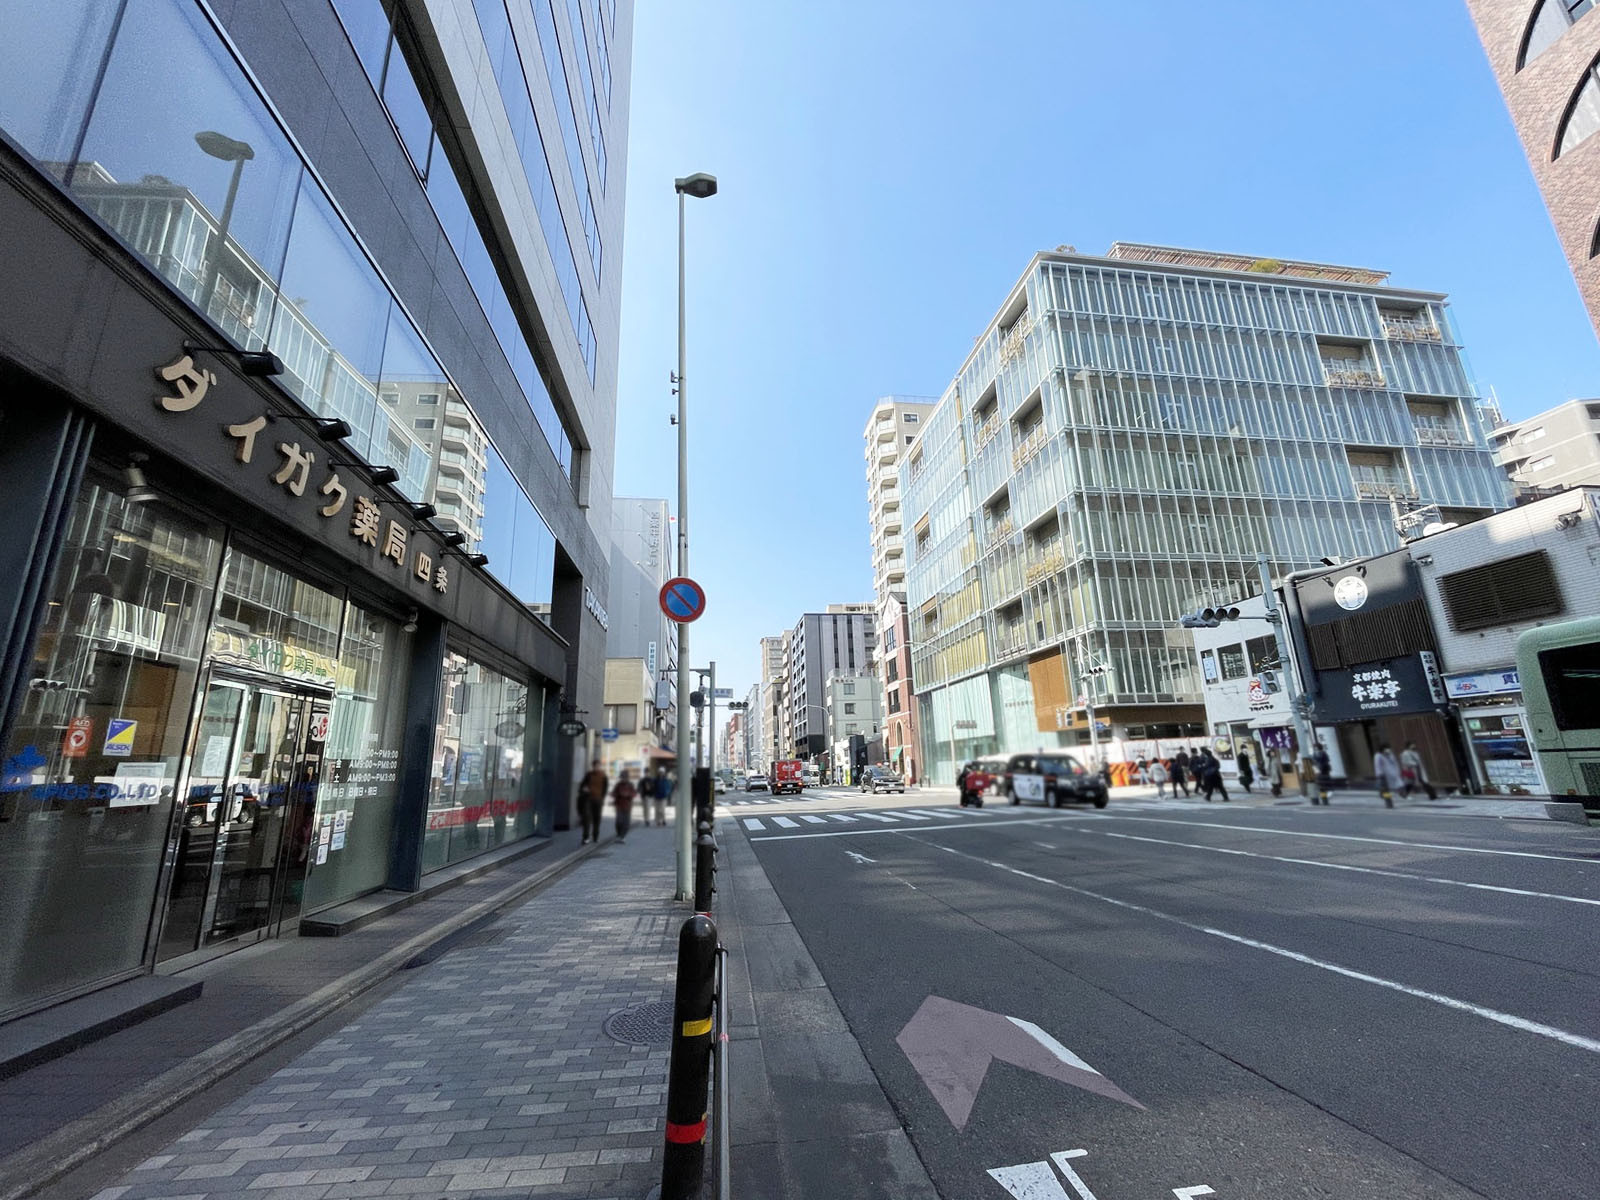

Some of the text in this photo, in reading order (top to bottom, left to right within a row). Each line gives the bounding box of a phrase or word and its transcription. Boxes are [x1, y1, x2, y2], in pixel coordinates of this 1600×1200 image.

[154, 355, 407, 566] ダイガク薬局
[1353, 669, 1391, 683] 京都焼肉
[1352, 680, 1401, 701] 牛楽亭
[1360, 700, 1399, 710] GYURAKUTEI
